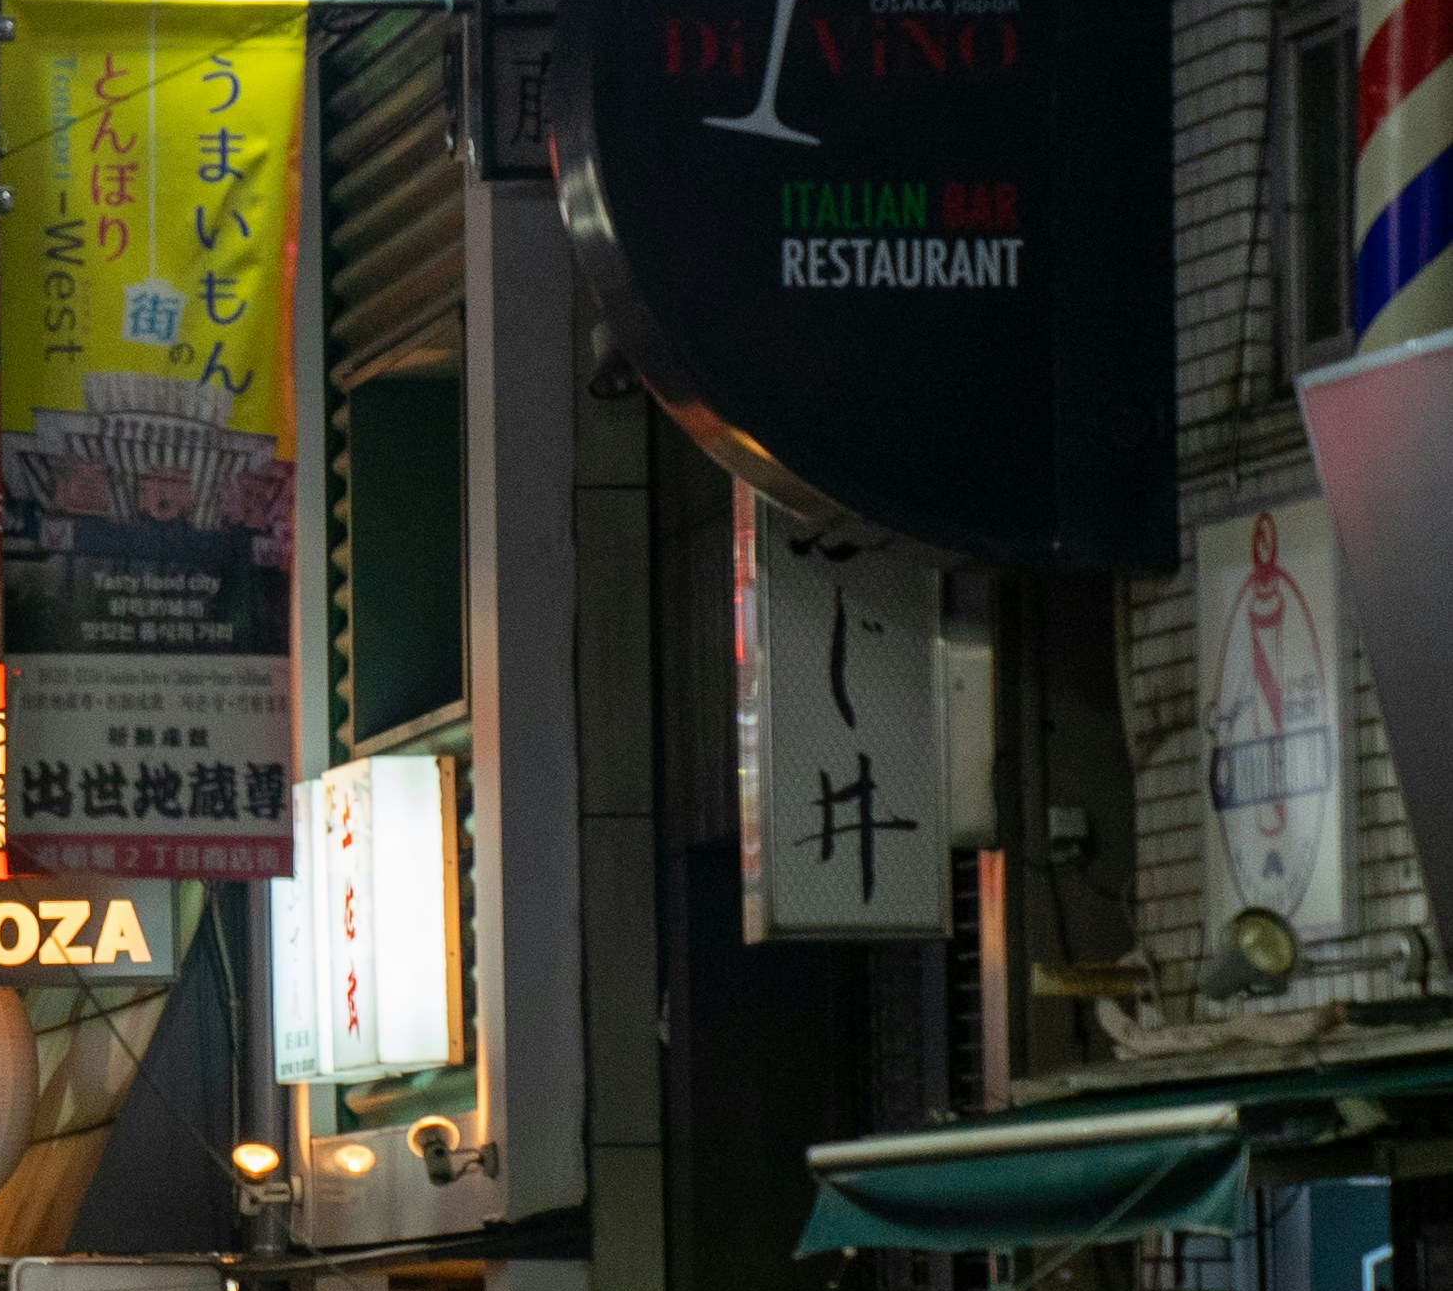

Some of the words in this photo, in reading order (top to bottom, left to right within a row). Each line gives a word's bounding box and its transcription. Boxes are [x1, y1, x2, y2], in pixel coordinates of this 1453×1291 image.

[89, 52, 138, 262] とんぼり
[195, 53, 265, 396] うまいもん
[780, 181, 928, 230] ITALIAN
[942, 181, 1018, 230] BAR
[780, 238, 1024, 289] RESTAURANT
[129, 290, 180, 343] 街
[189, 571, 232, 596] city
[21, 759, 285, 821] 出世地蔵尊
